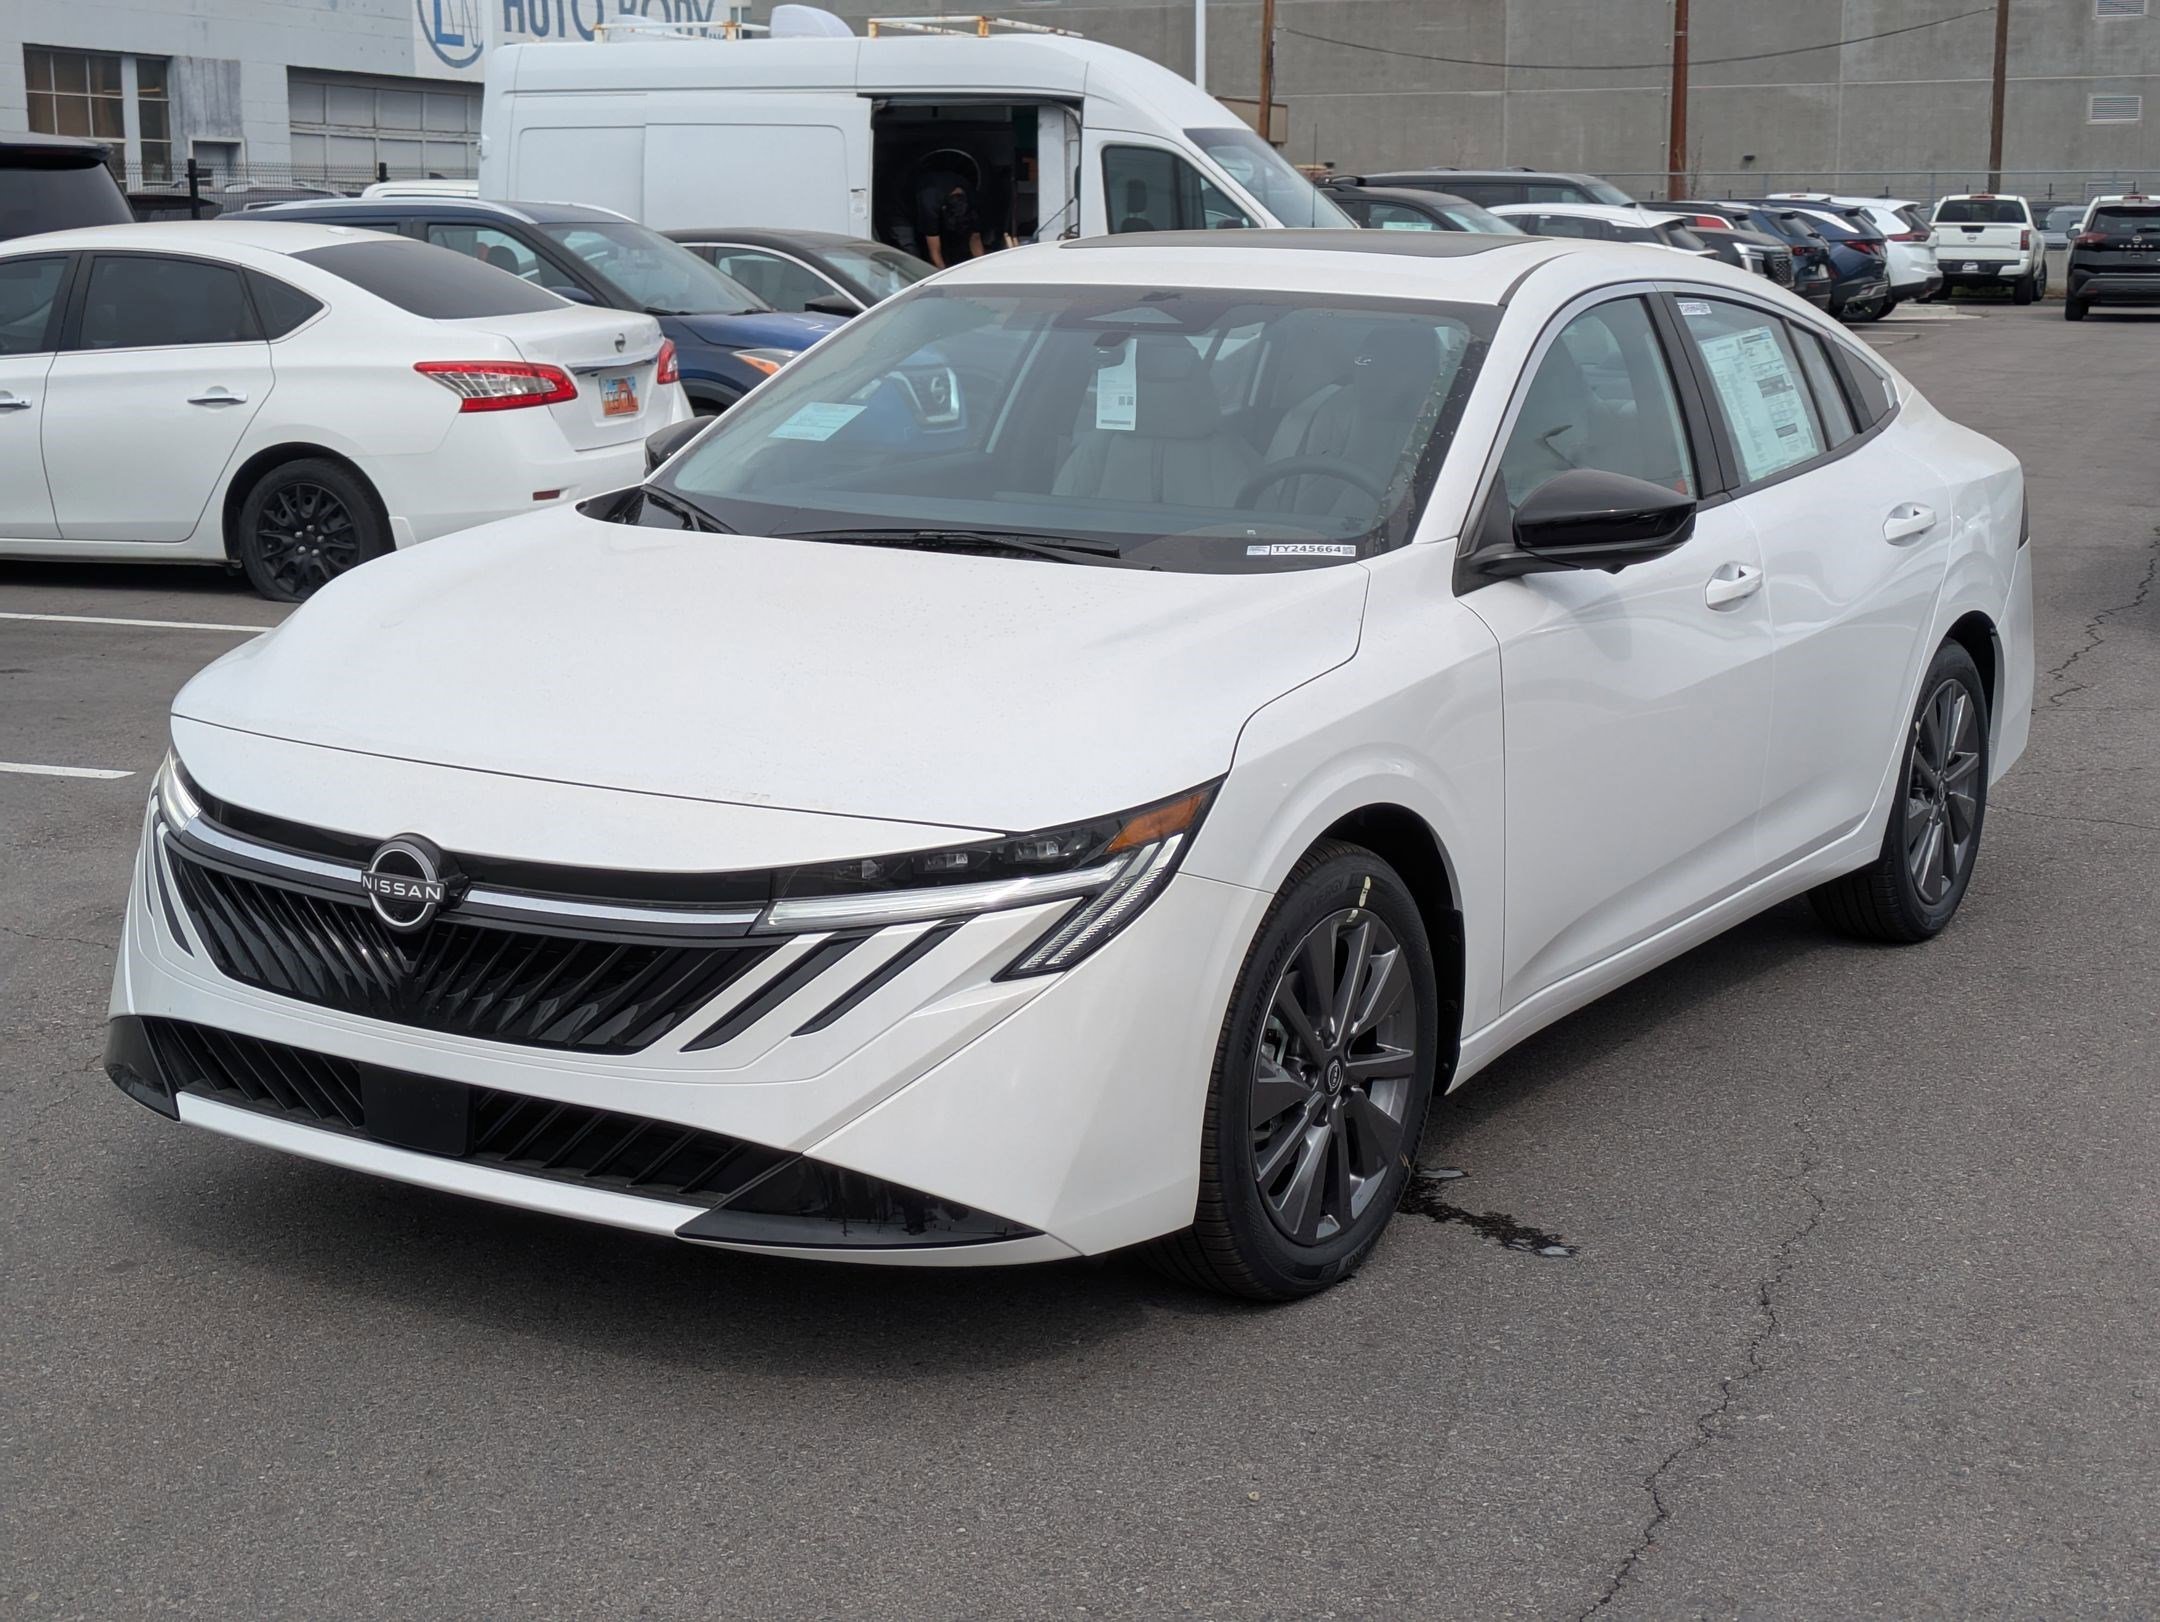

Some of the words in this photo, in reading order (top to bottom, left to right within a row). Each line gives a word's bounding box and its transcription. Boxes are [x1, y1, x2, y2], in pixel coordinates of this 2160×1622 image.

[619, 0, 715, 38] DY
[1274, 545, 1341, 553] TY245664
[363, 875, 440, 900] NISSAN
